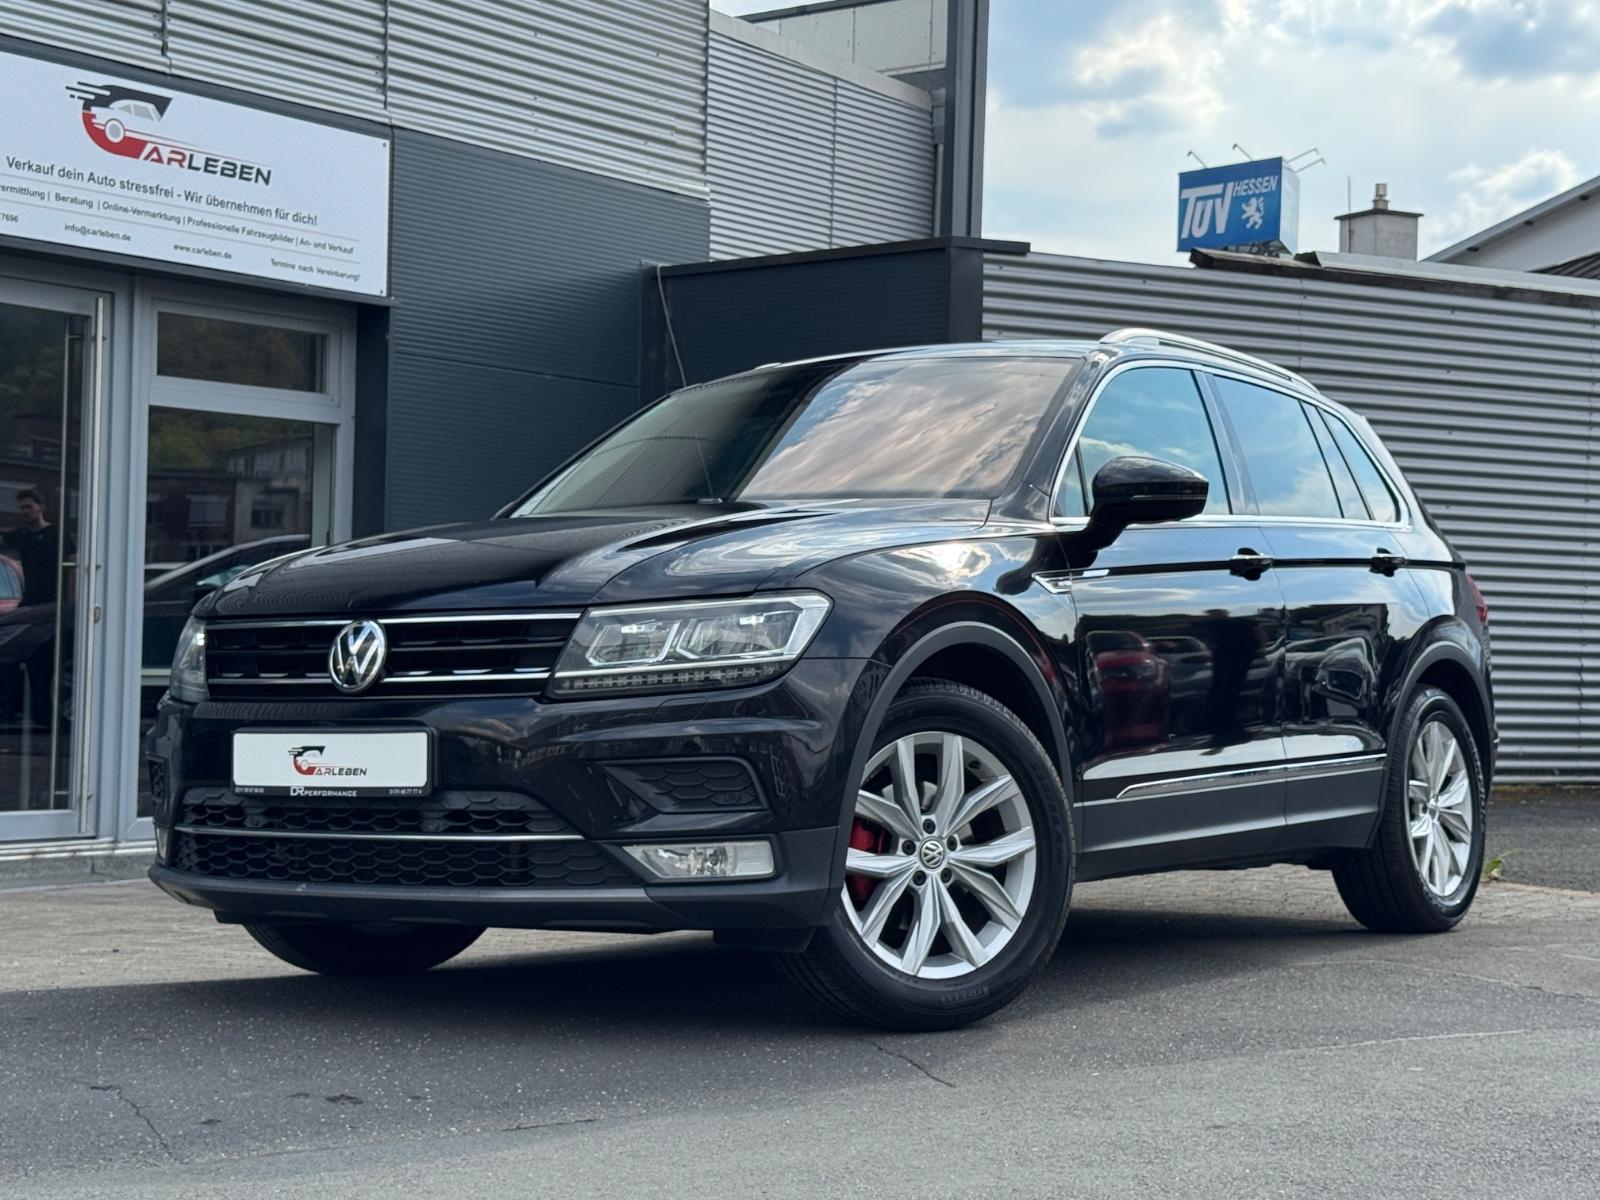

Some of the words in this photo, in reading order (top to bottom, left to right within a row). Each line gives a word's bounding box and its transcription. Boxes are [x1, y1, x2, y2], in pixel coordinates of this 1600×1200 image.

[6, 155, 55, 176] Verkauf
[58, 166, 84, 182] dein
[87, 171, 116, 187] Auto
[119, 179, 174, 199] stressfrei
[184, 189, 203, 204] Wir
[205, 194, 272, 218] übernehmen
[275, 207, 289, 221] für
[292, 211, 318, 226] dich!
[1233, 174, 1279, 197] HESSEN
[55, 192, 93, 209] Beratung
[102, 201, 181, 225] Online-Vermarktung
[313, 239, 326, 250] und
